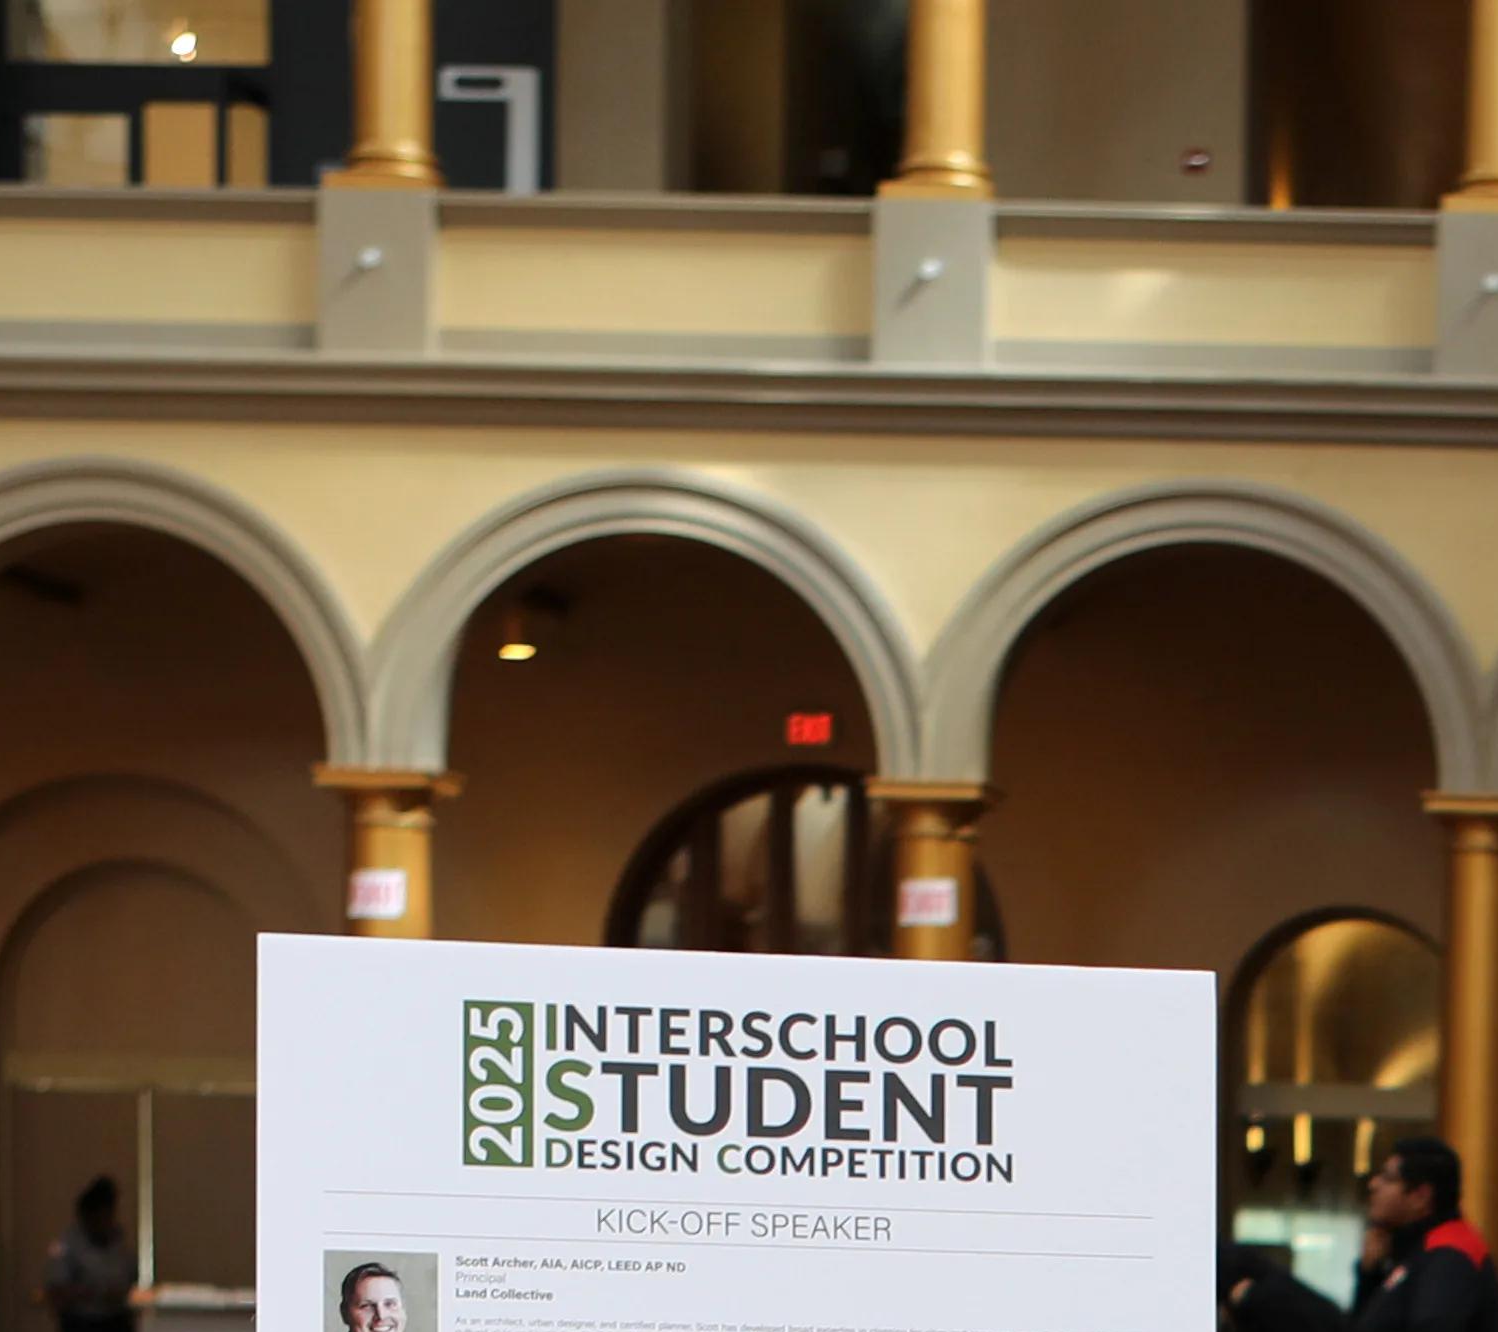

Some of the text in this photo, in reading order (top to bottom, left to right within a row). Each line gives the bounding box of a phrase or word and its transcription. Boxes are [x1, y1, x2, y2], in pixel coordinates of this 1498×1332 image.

[545, 1002, 1013, 1068] INTERSCHOOL
[469, 1007, 524, 1164] 2025
[543, 1058, 1013, 1146] STUDENT
[544, 1137, 1013, 1183] DESIGN COMPETITION
[596, 1208, 891, 1242] KICK-OFF SPEAKER
[455, 1255, 489, 1267] Scott
[491, 1256, 537, 1270] Archer,
[570, 1258, 605, 1272] AICP,
[607, 1259, 642, 1272] LEED
[644, 1260, 664, 1272] AP
[665, 1261, 686, 1273] ND
[454, 1287, 554, 1301] Land Collective
